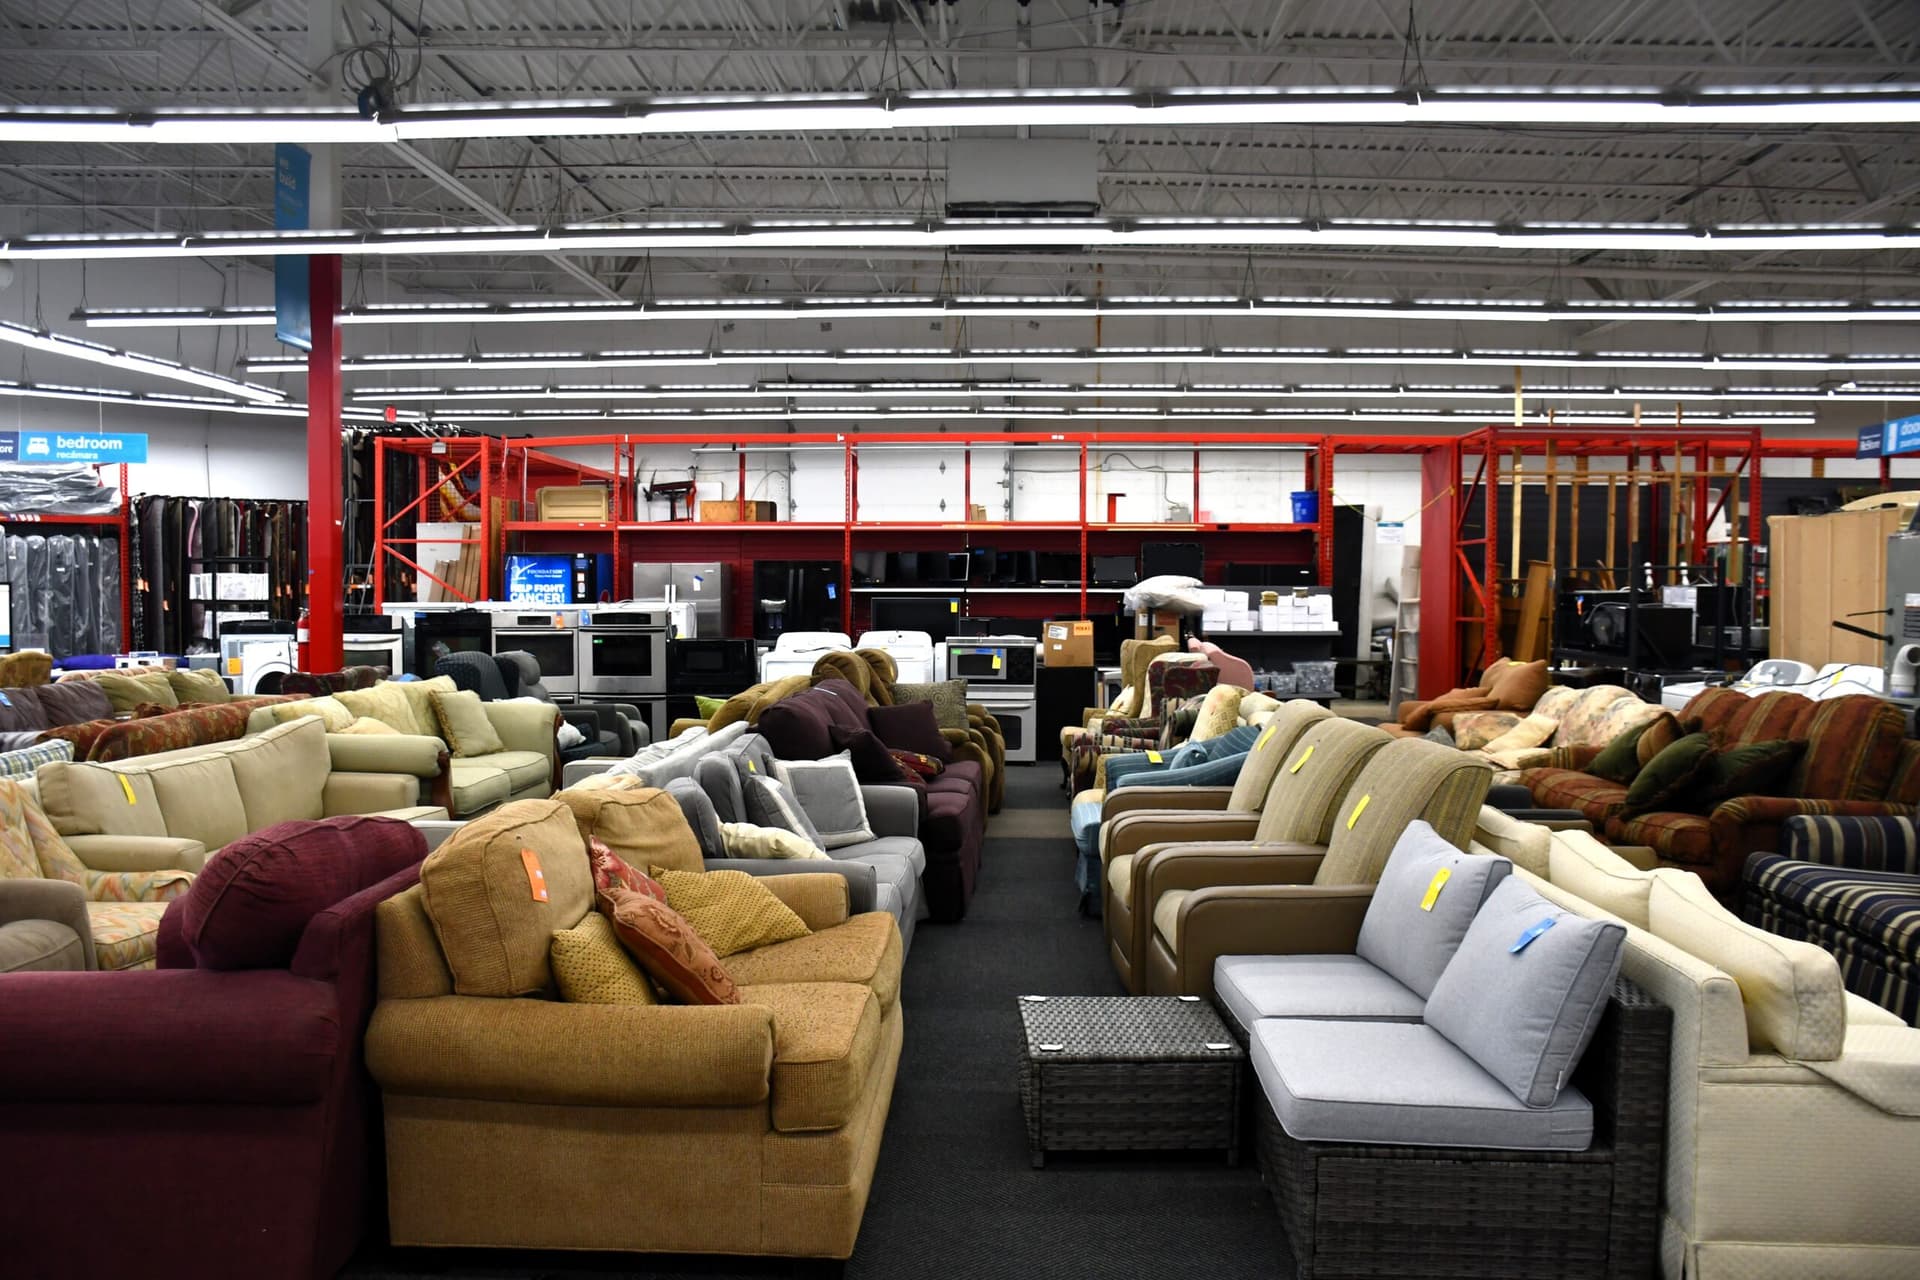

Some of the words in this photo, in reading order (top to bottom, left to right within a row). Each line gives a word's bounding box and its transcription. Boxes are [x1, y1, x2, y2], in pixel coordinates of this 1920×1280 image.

[56, 435, 122, 450] bedroom
[510, 584, 533, 593] HELP
[534, 584, 565, 593] FIGHT
[510, 593, 566, 603] CANCER!
